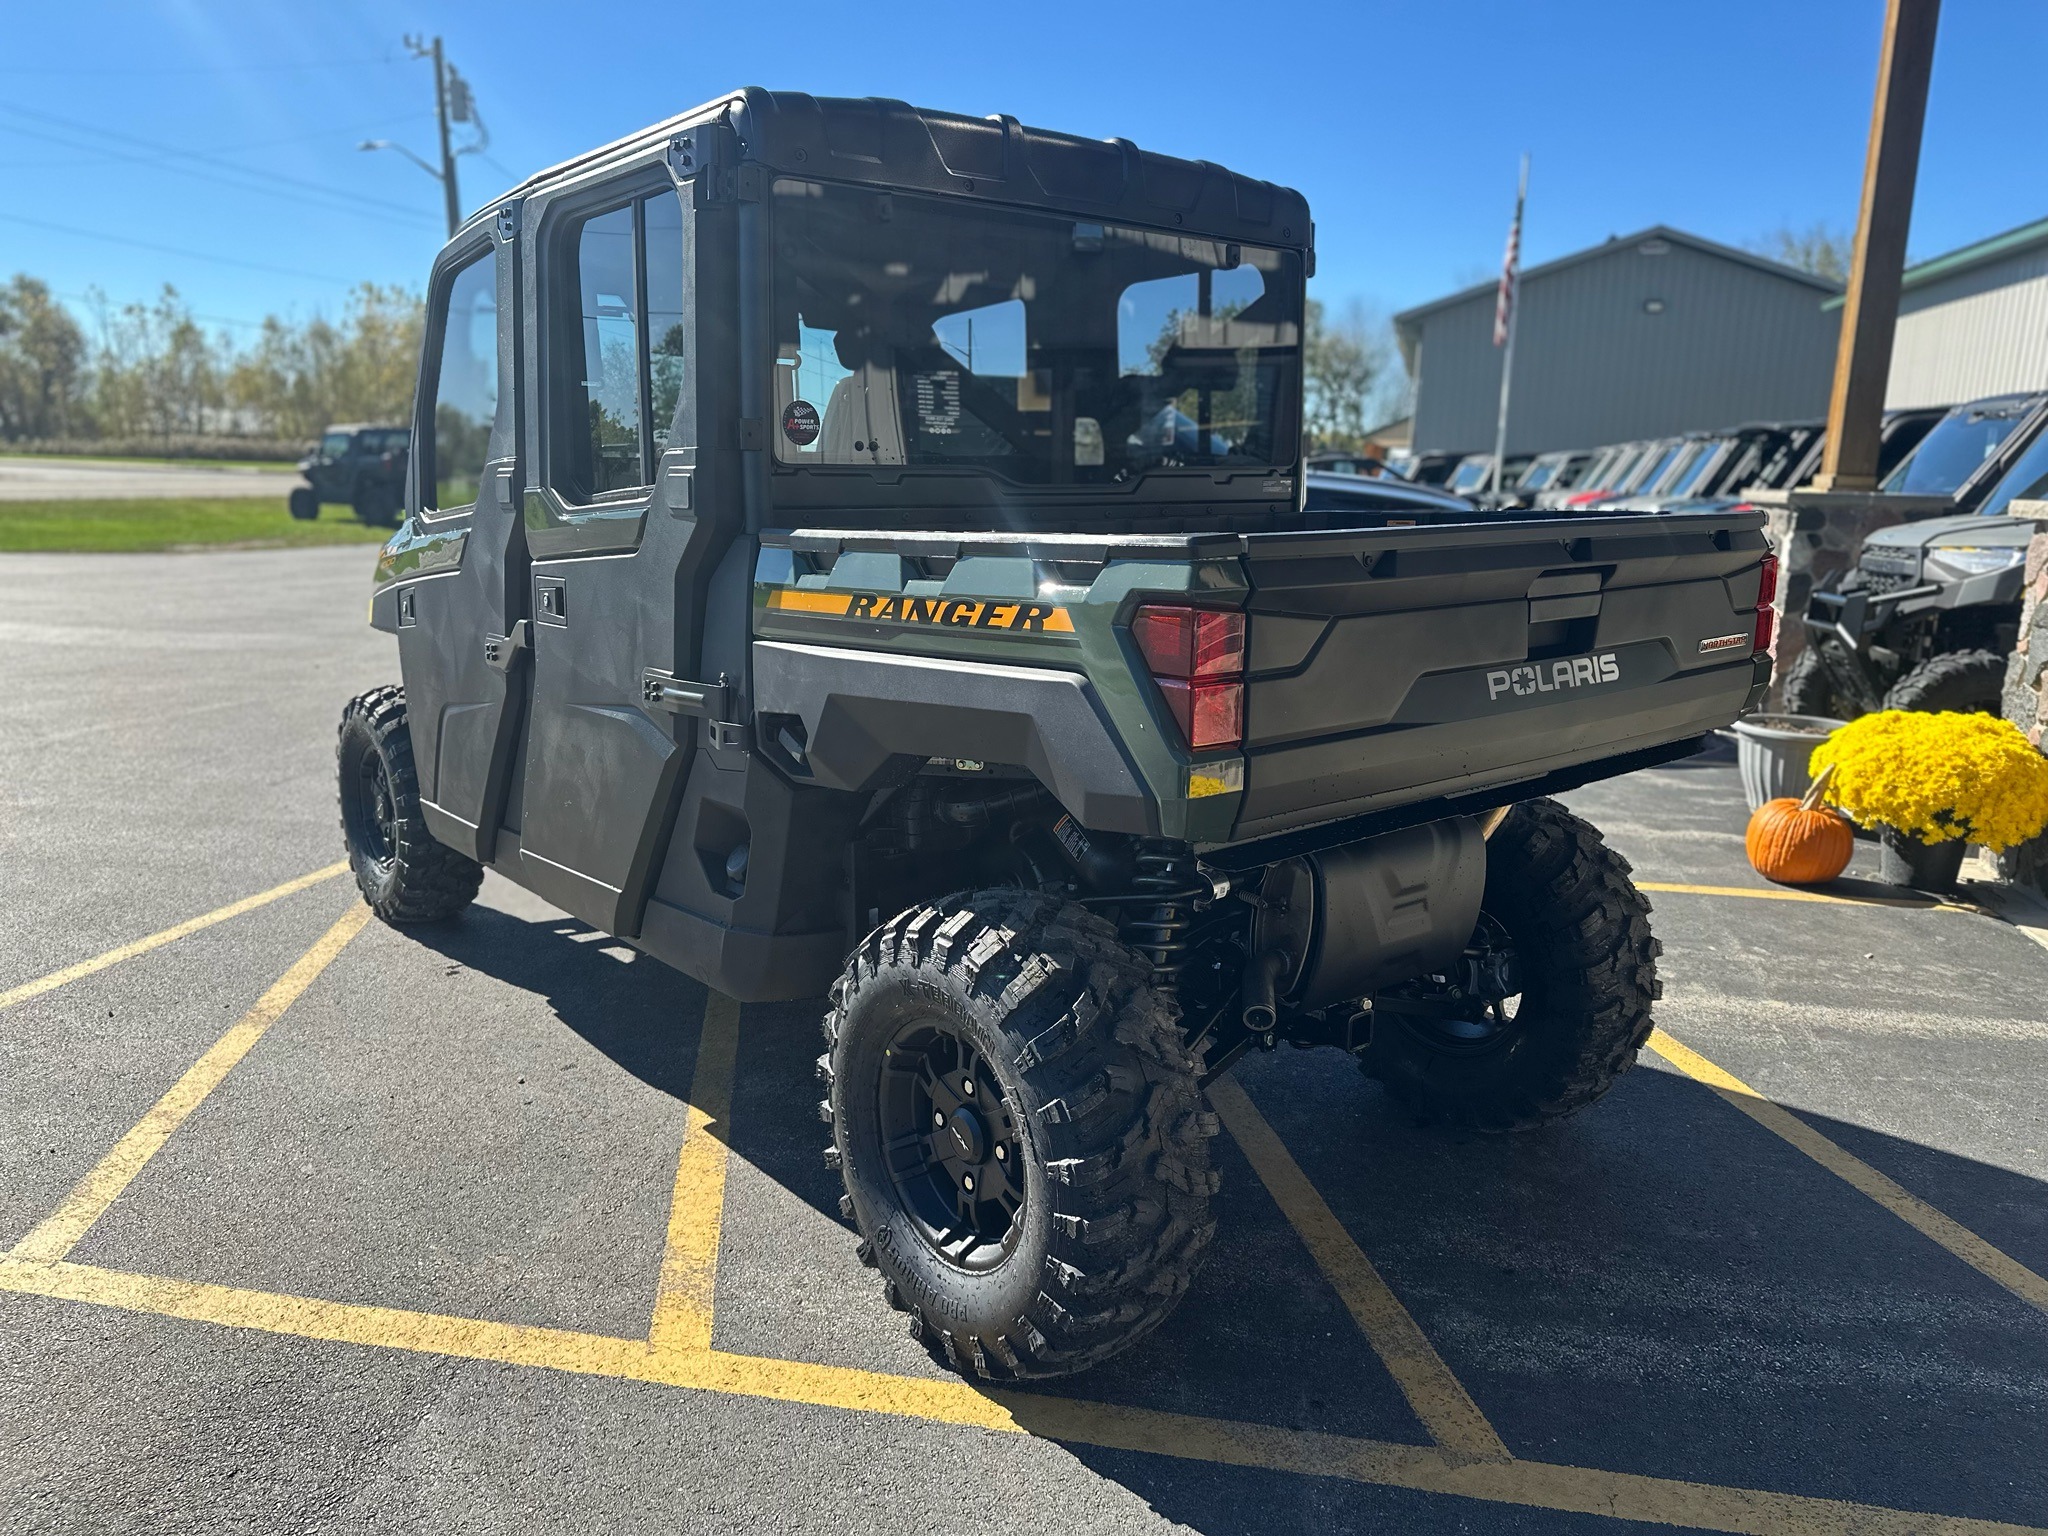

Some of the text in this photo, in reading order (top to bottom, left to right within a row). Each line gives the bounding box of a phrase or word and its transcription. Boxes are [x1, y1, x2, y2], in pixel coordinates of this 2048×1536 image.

[845, 592, 1054, 633] RANGER
[1700, 635, 1748, 652] NORTHSTAR
[1487, 653, 1620, 700] POLARIS
